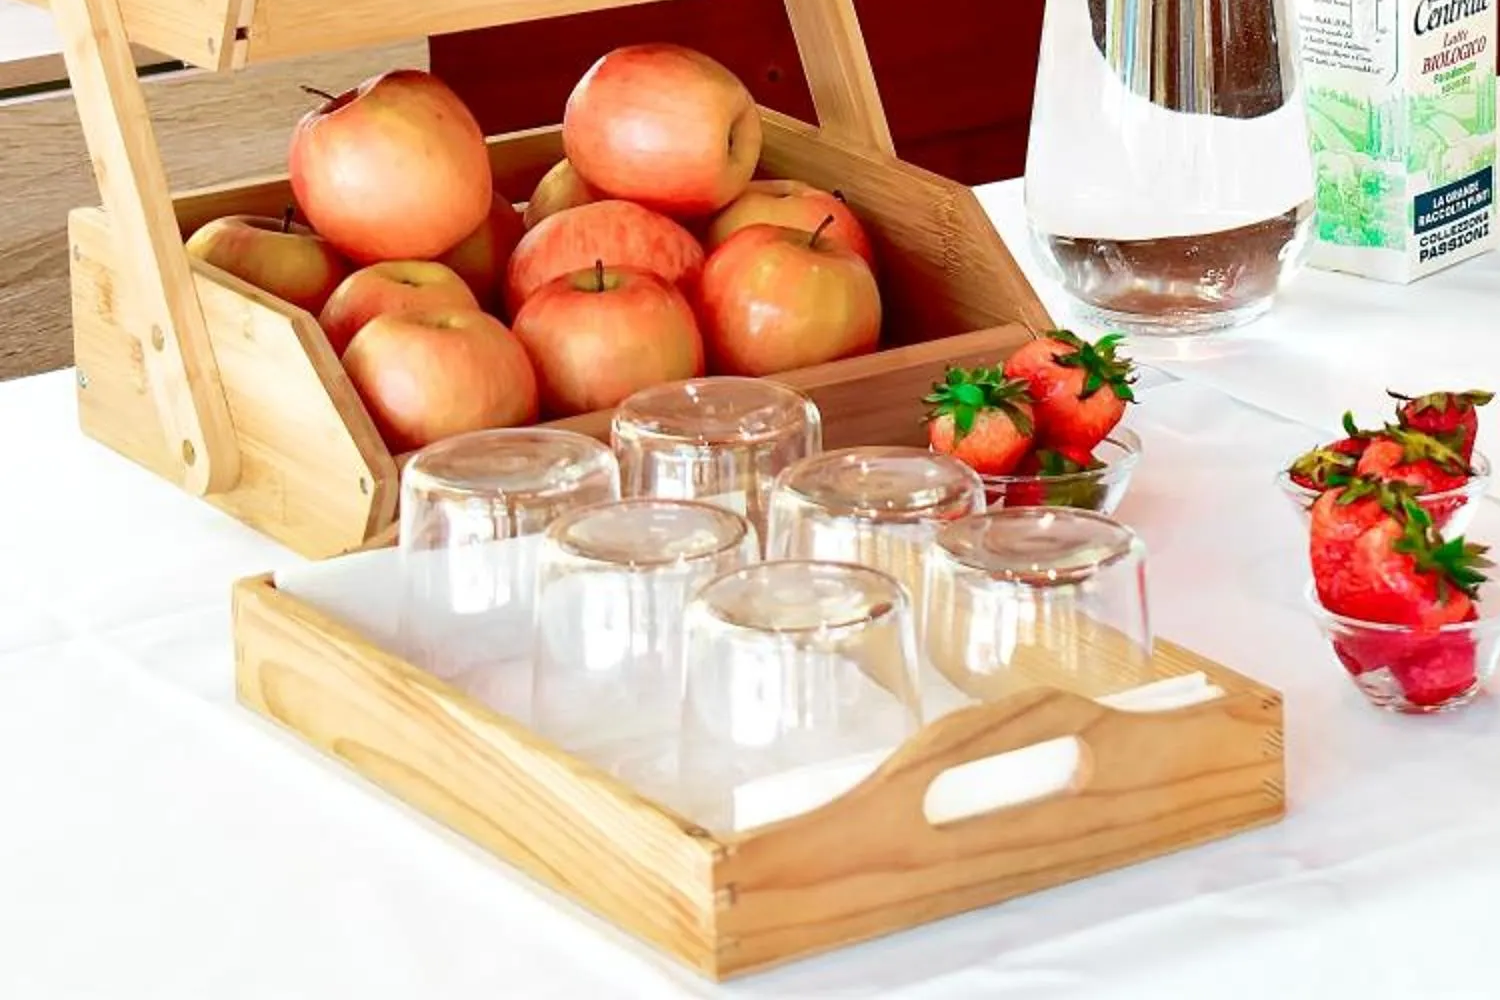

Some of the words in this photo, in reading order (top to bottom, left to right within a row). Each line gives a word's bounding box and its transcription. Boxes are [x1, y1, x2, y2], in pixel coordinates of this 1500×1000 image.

[1421, 34, 1487, 75] BIOLOGICO
[1432, 195, 1445, 209] LA
[1445, 180, 1479, 204] GRANDE
[1418, 200, 1467, 227] RACCOLTA
[1420, 222, 1489, 264] PASSIONI
